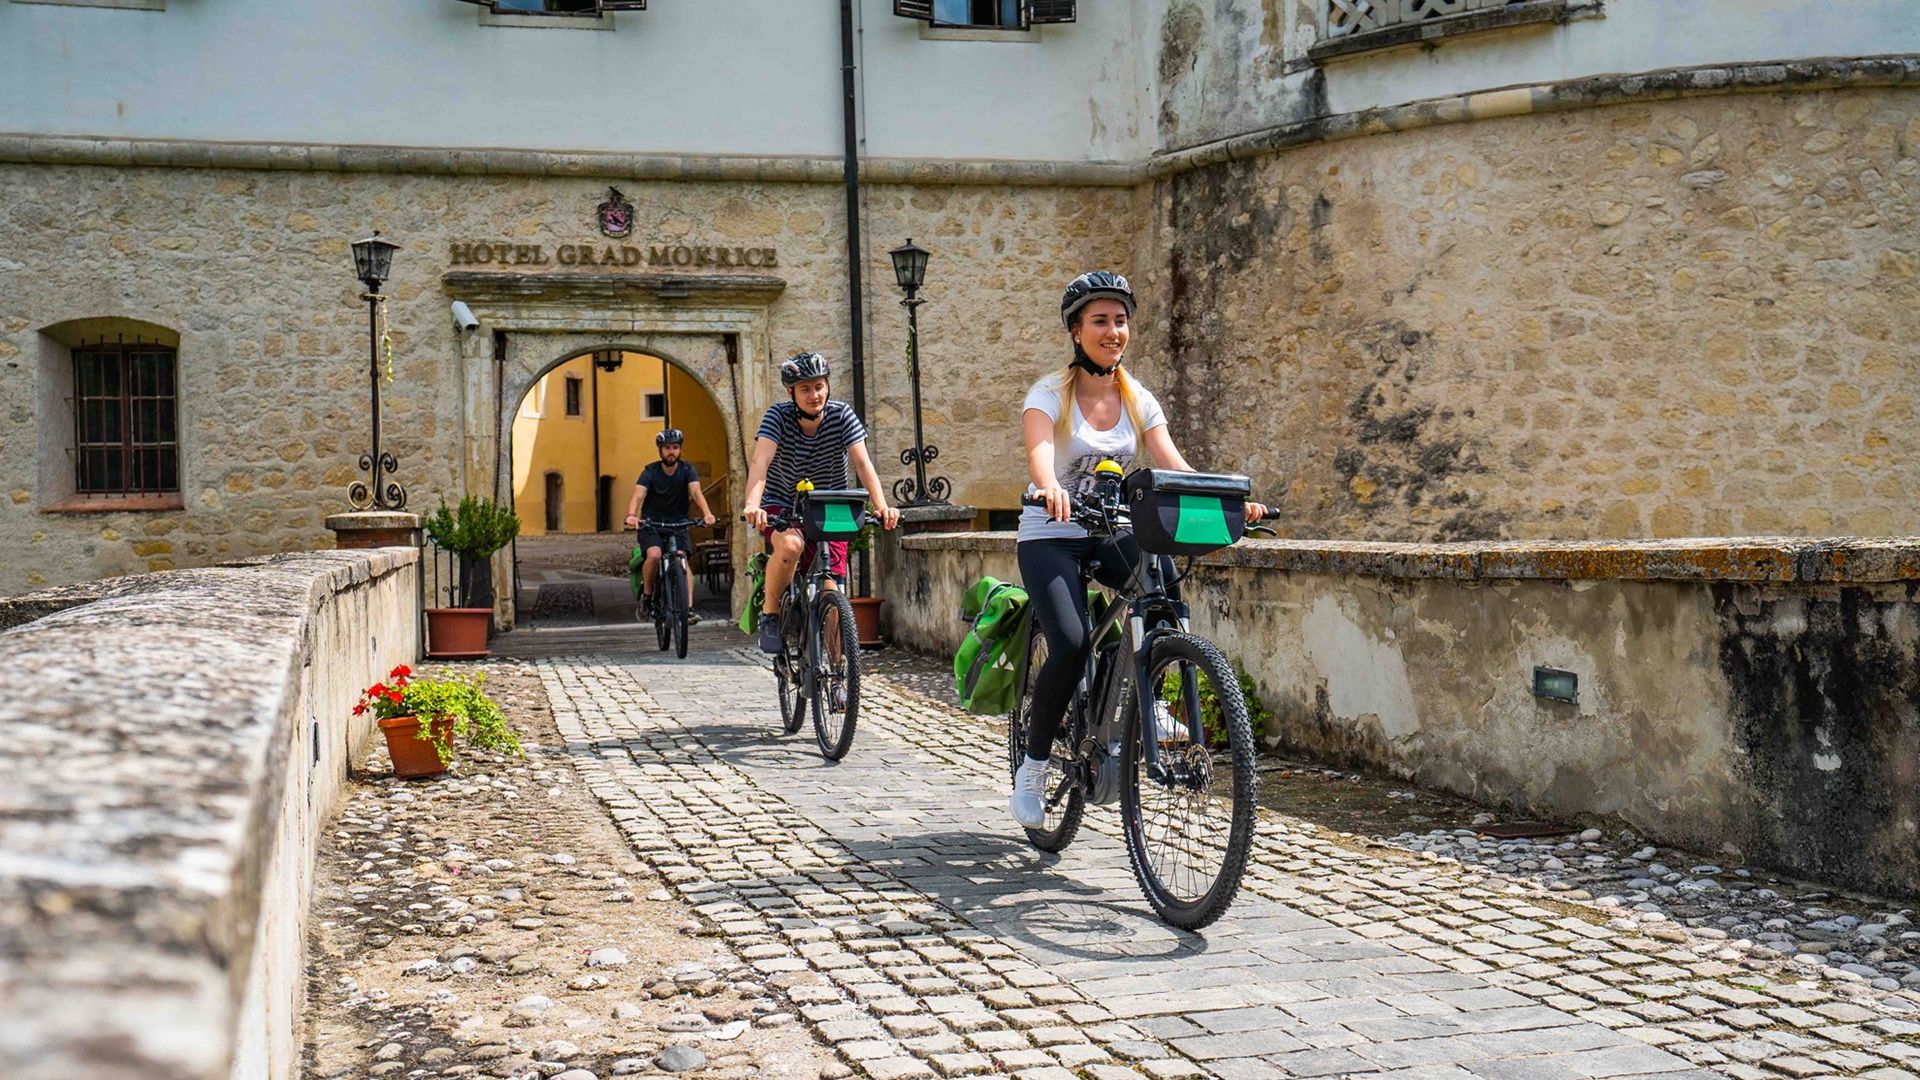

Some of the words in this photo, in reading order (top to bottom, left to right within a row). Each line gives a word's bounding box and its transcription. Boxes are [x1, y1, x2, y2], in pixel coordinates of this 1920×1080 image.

[450, 243, 549, 265] HOTEL
[556, 244, 643, 266] GRAD
[648, 246, 778, 268] MOKRICE
